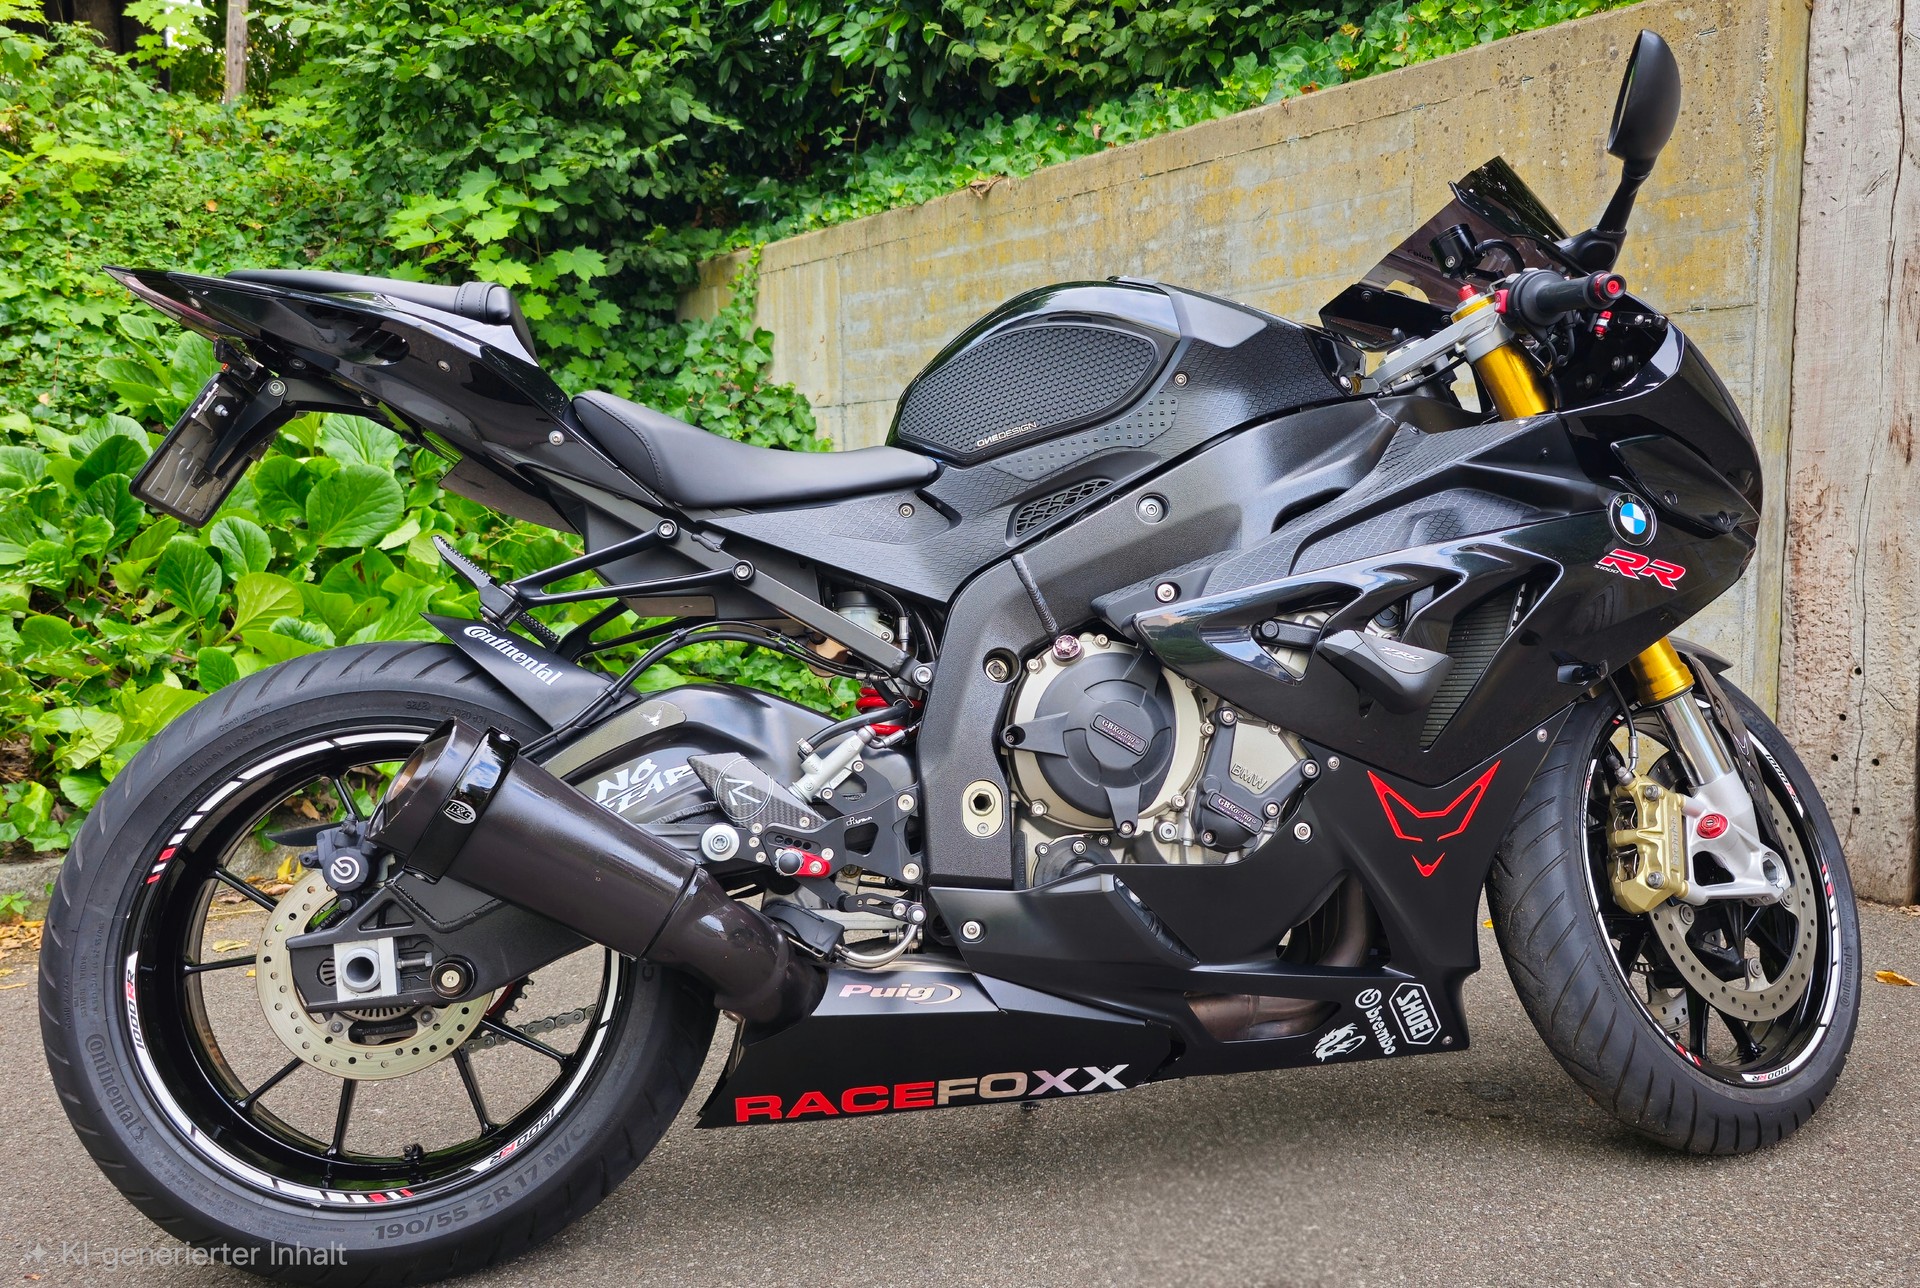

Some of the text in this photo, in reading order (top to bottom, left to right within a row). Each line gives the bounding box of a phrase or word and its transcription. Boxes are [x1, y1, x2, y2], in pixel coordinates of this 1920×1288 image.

[1592, 548, 1687, 591] S1000 RR
[463, 625, 563, 686] Continental
[595, 758, 658, 804] NO
[1231, 763, 1268, 790] BMW
[448, 802, 473, 819] R&G
[1217, 798, 1253, 823] GBRacing
[126, 968, 145, 1050] 1000RR
[839, 983, 936, 1001] Puig
[1396, 988, 1435, 1040] SHOEI
[1365, 1005, 1397, 1055] brembo
[85, 1033, 139, 1131] Continental
[735, 1064, 1130, 1123] RACEFOXX
[489, 1107, 555, 1165] 1000RR
[375, 1205, 469, 1240] 190/55
[475, 1184, 512, 1211] ZR
[514, 1165, 538, 1188] 17
[545, 1124, 586, 1168] M/C
